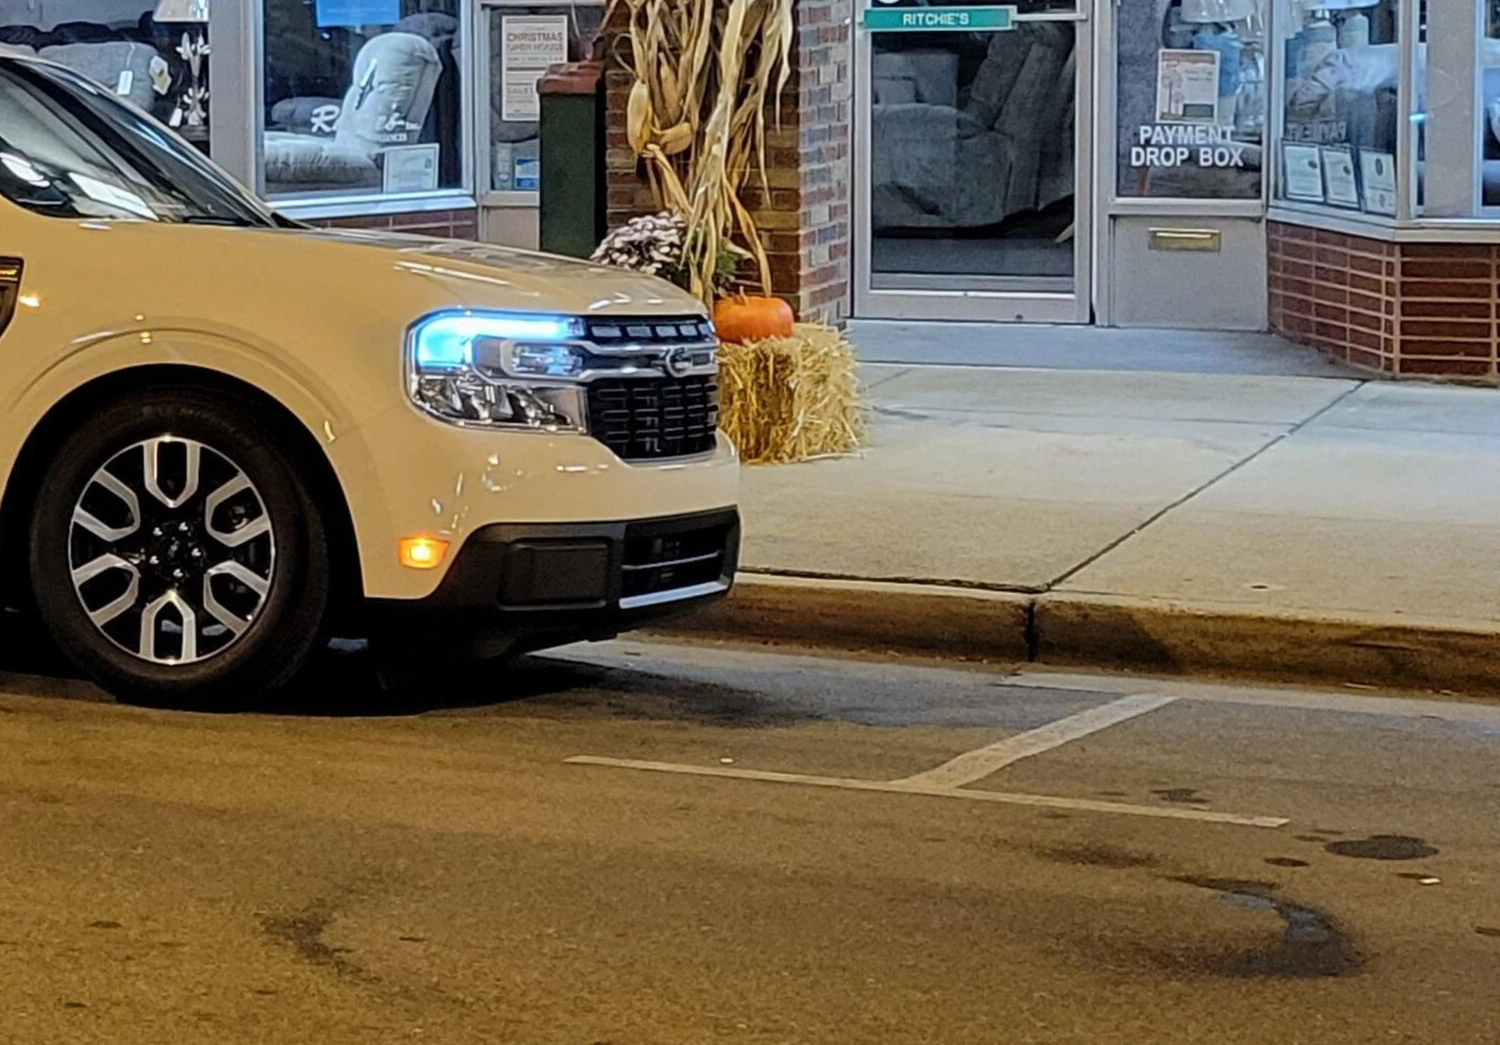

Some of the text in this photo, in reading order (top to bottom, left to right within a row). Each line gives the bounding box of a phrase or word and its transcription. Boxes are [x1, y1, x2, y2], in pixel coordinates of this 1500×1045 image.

[902, 12, 970, 26] RITCHIE'S
[507, 32, 564, 42] CHRISTMAS
[1139, 124, 1236, 145] PAYMENT
[1130, 146, 1245, 167] DROP BOX
